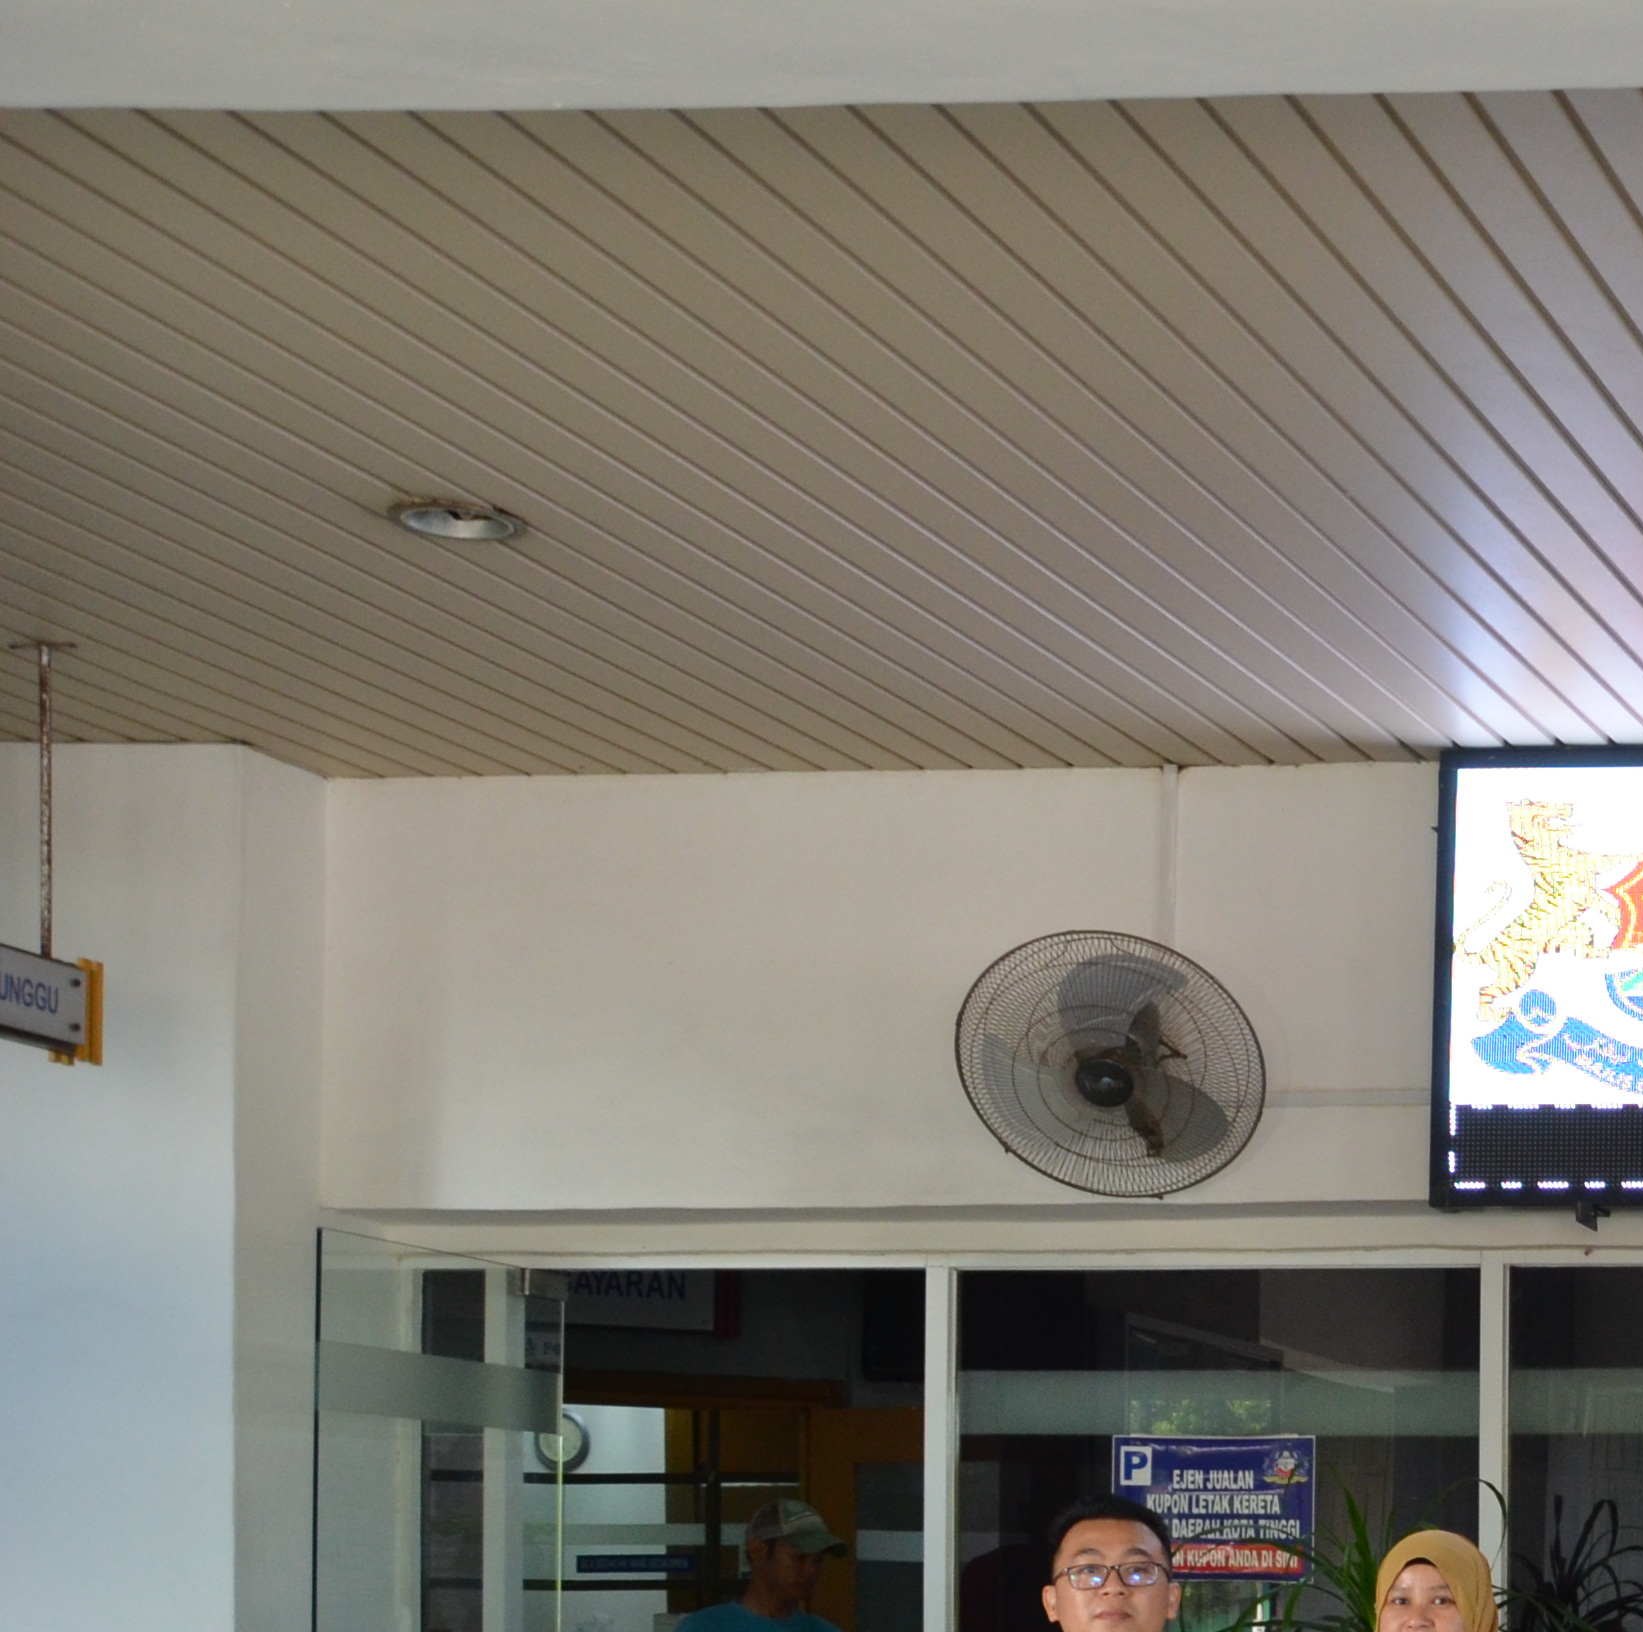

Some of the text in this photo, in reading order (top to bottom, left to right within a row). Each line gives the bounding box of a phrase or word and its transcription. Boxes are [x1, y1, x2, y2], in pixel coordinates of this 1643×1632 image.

[567, 1270, 686, 1300] AYARAN
[1124, 1451, 1148, 1481] P
[1173, 1470, 1254, 1490] EJEN JUALAN
[1147, 1494, 1280, 1515] KUPON LETAK KERETA
[1172, 1519, 1220, 1539] DAERAH
[1223, 1520, 1256, 1540] KOTA
[1259, 1520, 1300, 1540] TINGGI
[1187, 1549, 1226, 1567] KUPON
[1229, 1549, 1258, 1568] ANDA
[1261, 1550, 1273, 1568] DI
